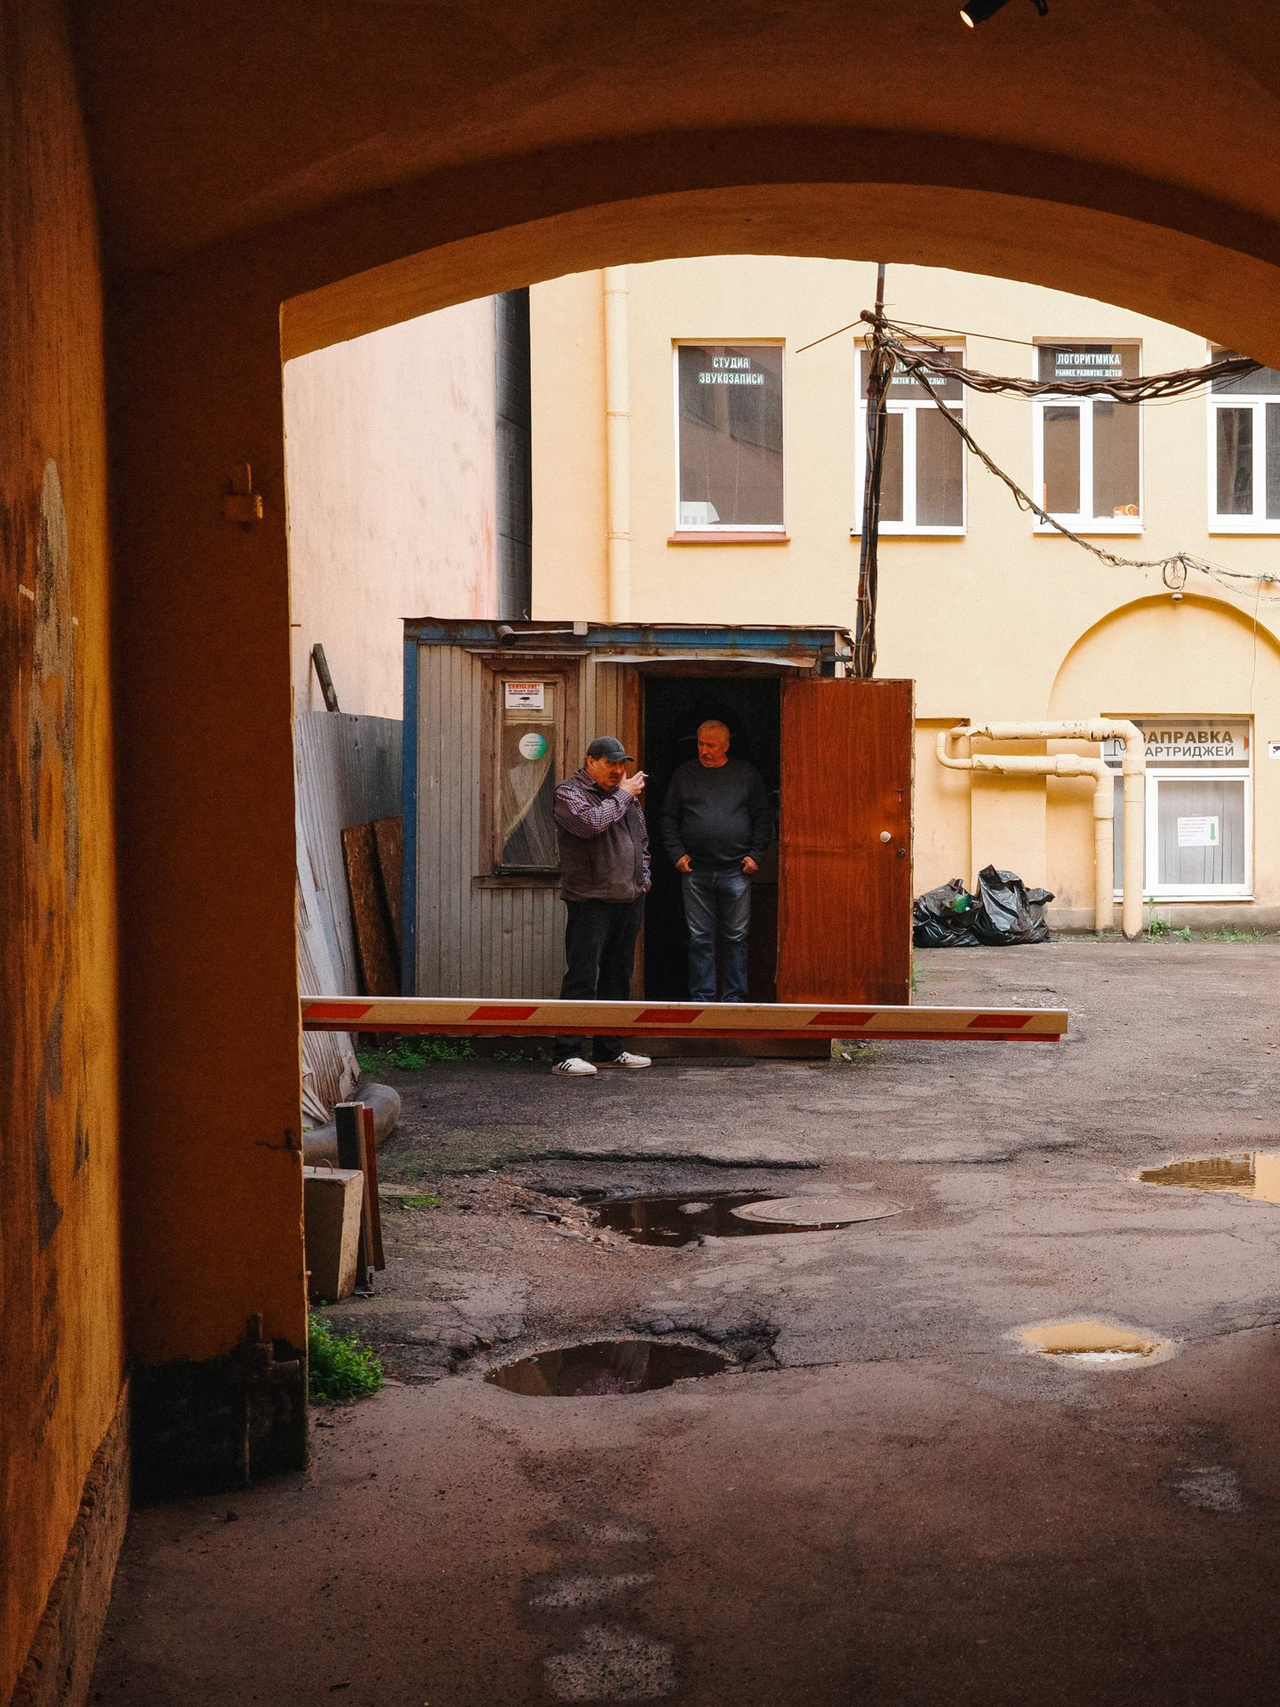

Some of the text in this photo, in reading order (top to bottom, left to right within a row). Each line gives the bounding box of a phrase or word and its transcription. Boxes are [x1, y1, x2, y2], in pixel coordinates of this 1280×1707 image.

[713, 357, 749, 368] СТУДИЯ
[1057, 354, 1120, 364] ЛОГОРИТМИКА
[1056, 369, 1122, 377] РАННЕЕ РАЗВИТИЕ ДЕТЕЙ
[700, 373, 763, 385] ЗВУКОЗАПИСИ
[1145, 744, 1234, 758] АРТРИДЖЕЙ
